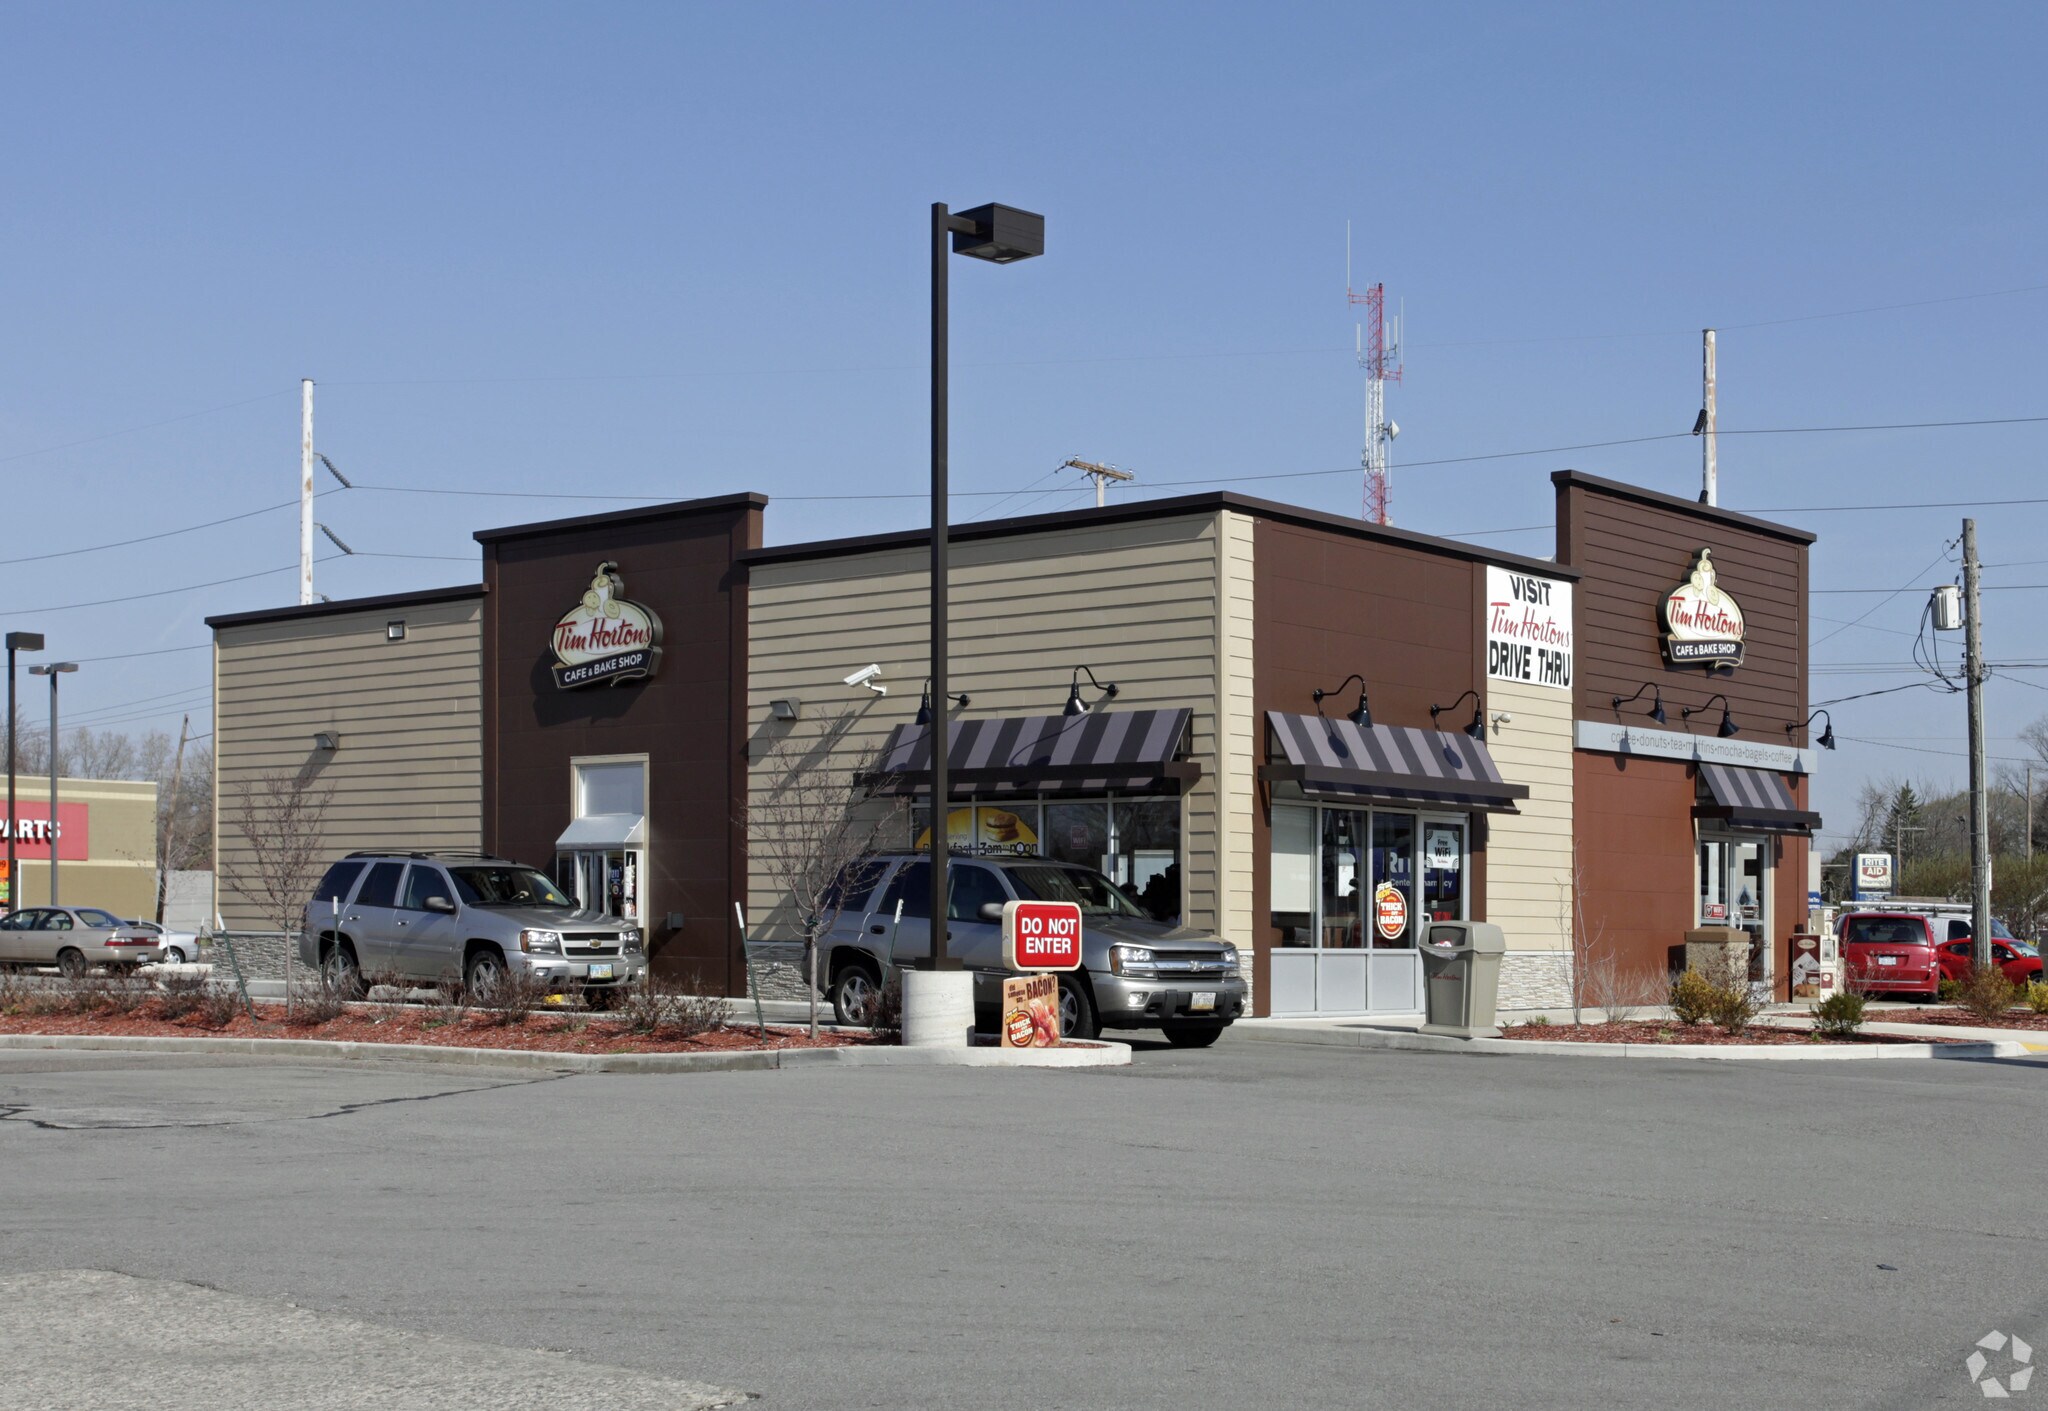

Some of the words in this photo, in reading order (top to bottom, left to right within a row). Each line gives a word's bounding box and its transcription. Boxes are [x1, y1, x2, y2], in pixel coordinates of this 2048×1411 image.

[1509, 574, 1551, 606] VISIT
[1669, 596, 1693, 628] Tim
[1694, 600, 1742, 636] Hortons
[1490, 602, 1518, 637] Tim
[1520, 606, 1569, 648] Hortons
[555, 620, 587, 652] Tim
[589, 617, 650, 649] Hortons
[1675, 644, 1694, 656] CAFE
[1699, 643, 1718, 655] BAKE
[1718, 643, 1736, 655] SHOP
[564, 667, 587, 682] CAFE
[588, 667, 593, 677] &
[593, 658, 617, 675] BAKE
[618, 653, 643, 668] SHOP
[1489, 640, 1531, 680] DRIVE
[1538, 648, 1570, 686] THRU
[1640, 733, 1667, 749] donuts
[1670, 739, 1683, 750] tea
[1685, 741, 1715, 755] mffins
[1717, 745, 1743, 757] mocha
[1744, 746, 1769, 763] bagels
[1770, 752, 1793, 764] coffee
[923, 842, 973, 855] Bkfast
[1434, 847, 1451, 857] WiFi
[1865, 858, 1885, 866] RITE
[1866, 867, 1884, 876] AID
[1380, 902, 1403, 911] THICK
[1021, 917, 1042, 934] DO
[1048, 918, 1076, 935] NOT
[1380, 915, 1404, 925] BACON
[1026, 937, 1071, 954] ENTER
[1010, 1017, 1031, 1031] THICK
[1011, 1027, 1033, 1041] BACON
